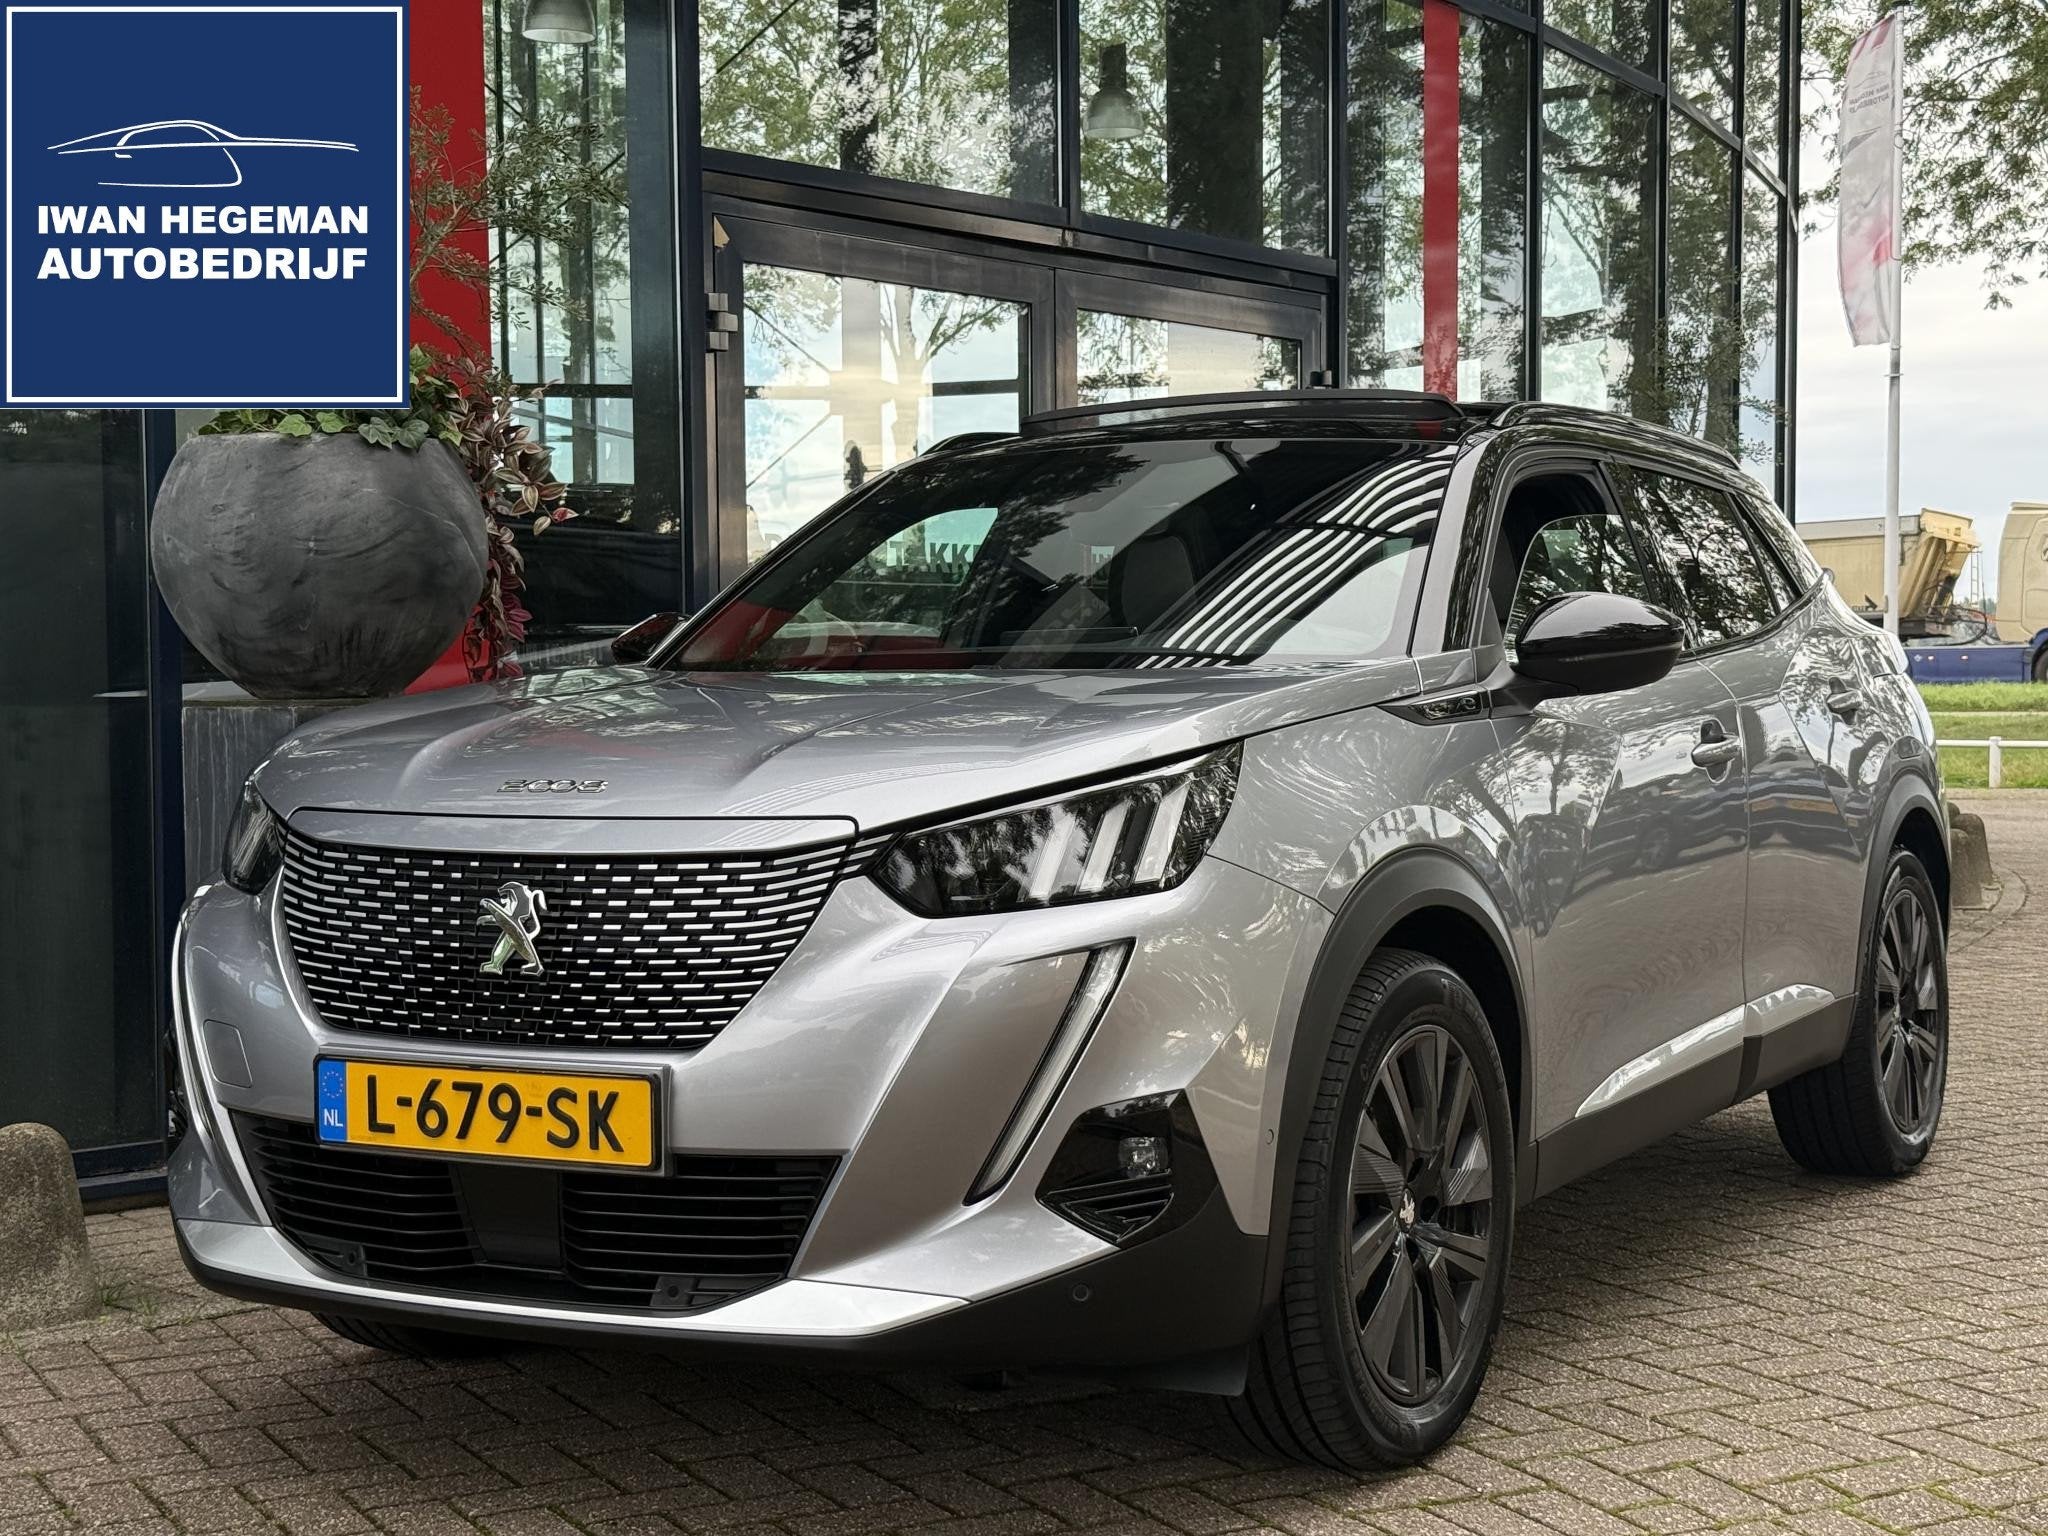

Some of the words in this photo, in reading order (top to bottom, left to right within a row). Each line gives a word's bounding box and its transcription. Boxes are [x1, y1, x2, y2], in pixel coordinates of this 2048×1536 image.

[497, 779, 608, 793] 2008
[323, 1108, 344, 1127] NL
[367, 1074, 624, 1152] L-679-SK
